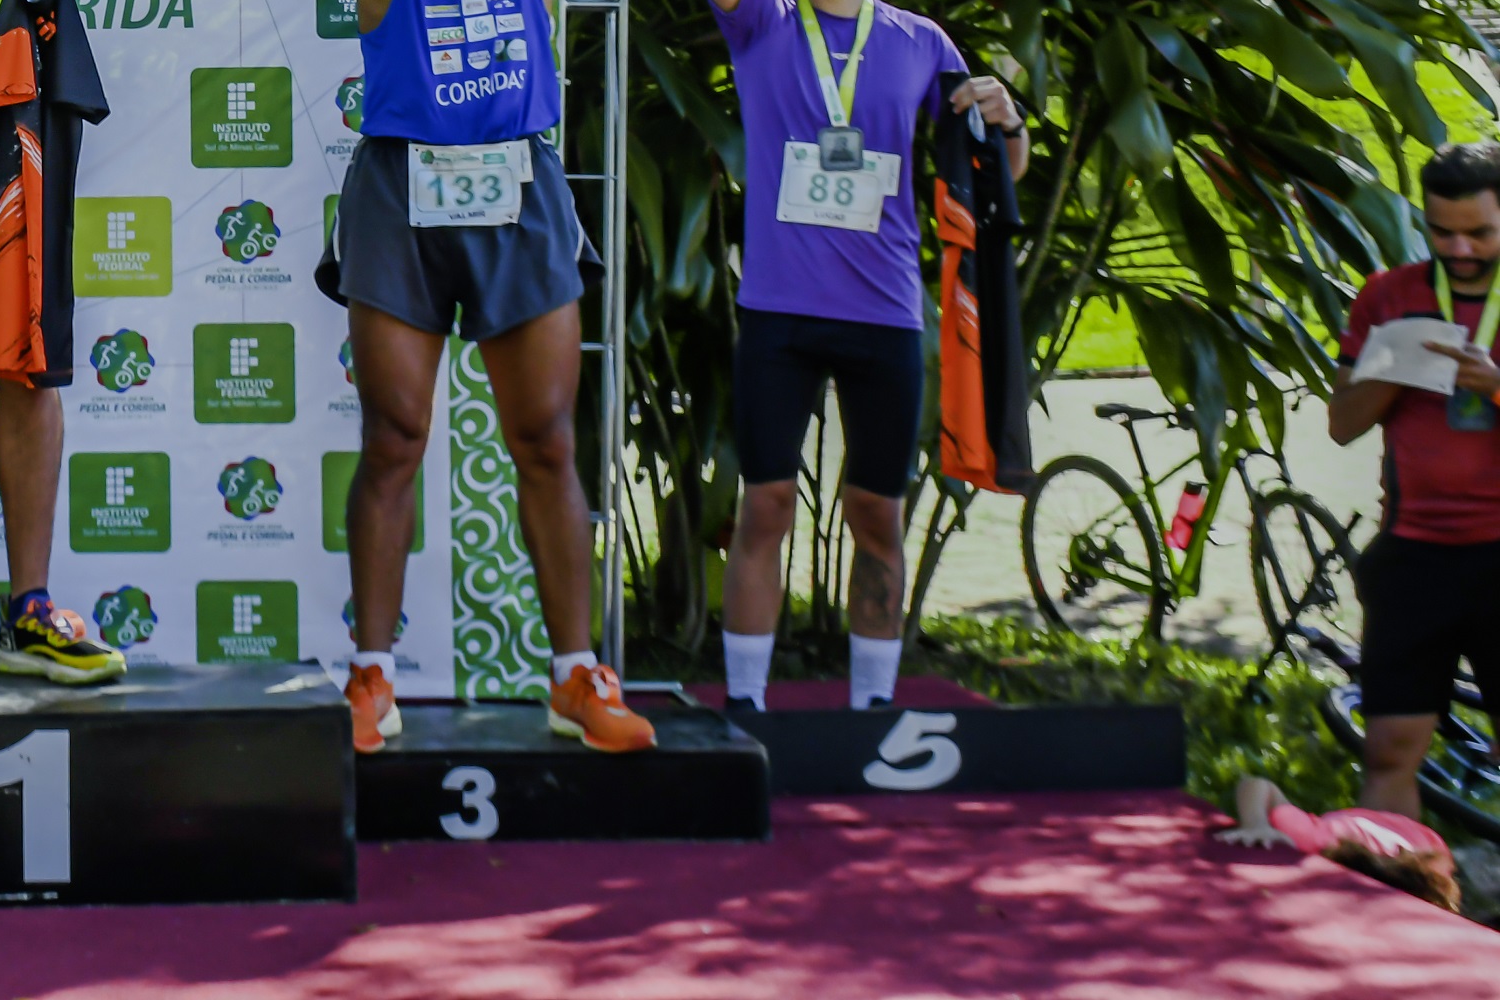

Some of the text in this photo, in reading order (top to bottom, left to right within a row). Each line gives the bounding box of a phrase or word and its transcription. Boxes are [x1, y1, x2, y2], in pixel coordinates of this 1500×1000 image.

[213, 123, 270, 133] INSTITUTO
[218, 132, 265, 142] FEDERAL
[427, 174, 502, 207] 133
[808, 174, 855, 206] 88
[93, 253, 150, 262] INSTITUTO
[98, 262, 144, 271] FEDERAL
[216, 379, 273, 388] INSTITUTO
[221, 388, 268, 397] FEDERAL
[863, 710, 962, 790] 5
[439, 766, 500, 840] 3
